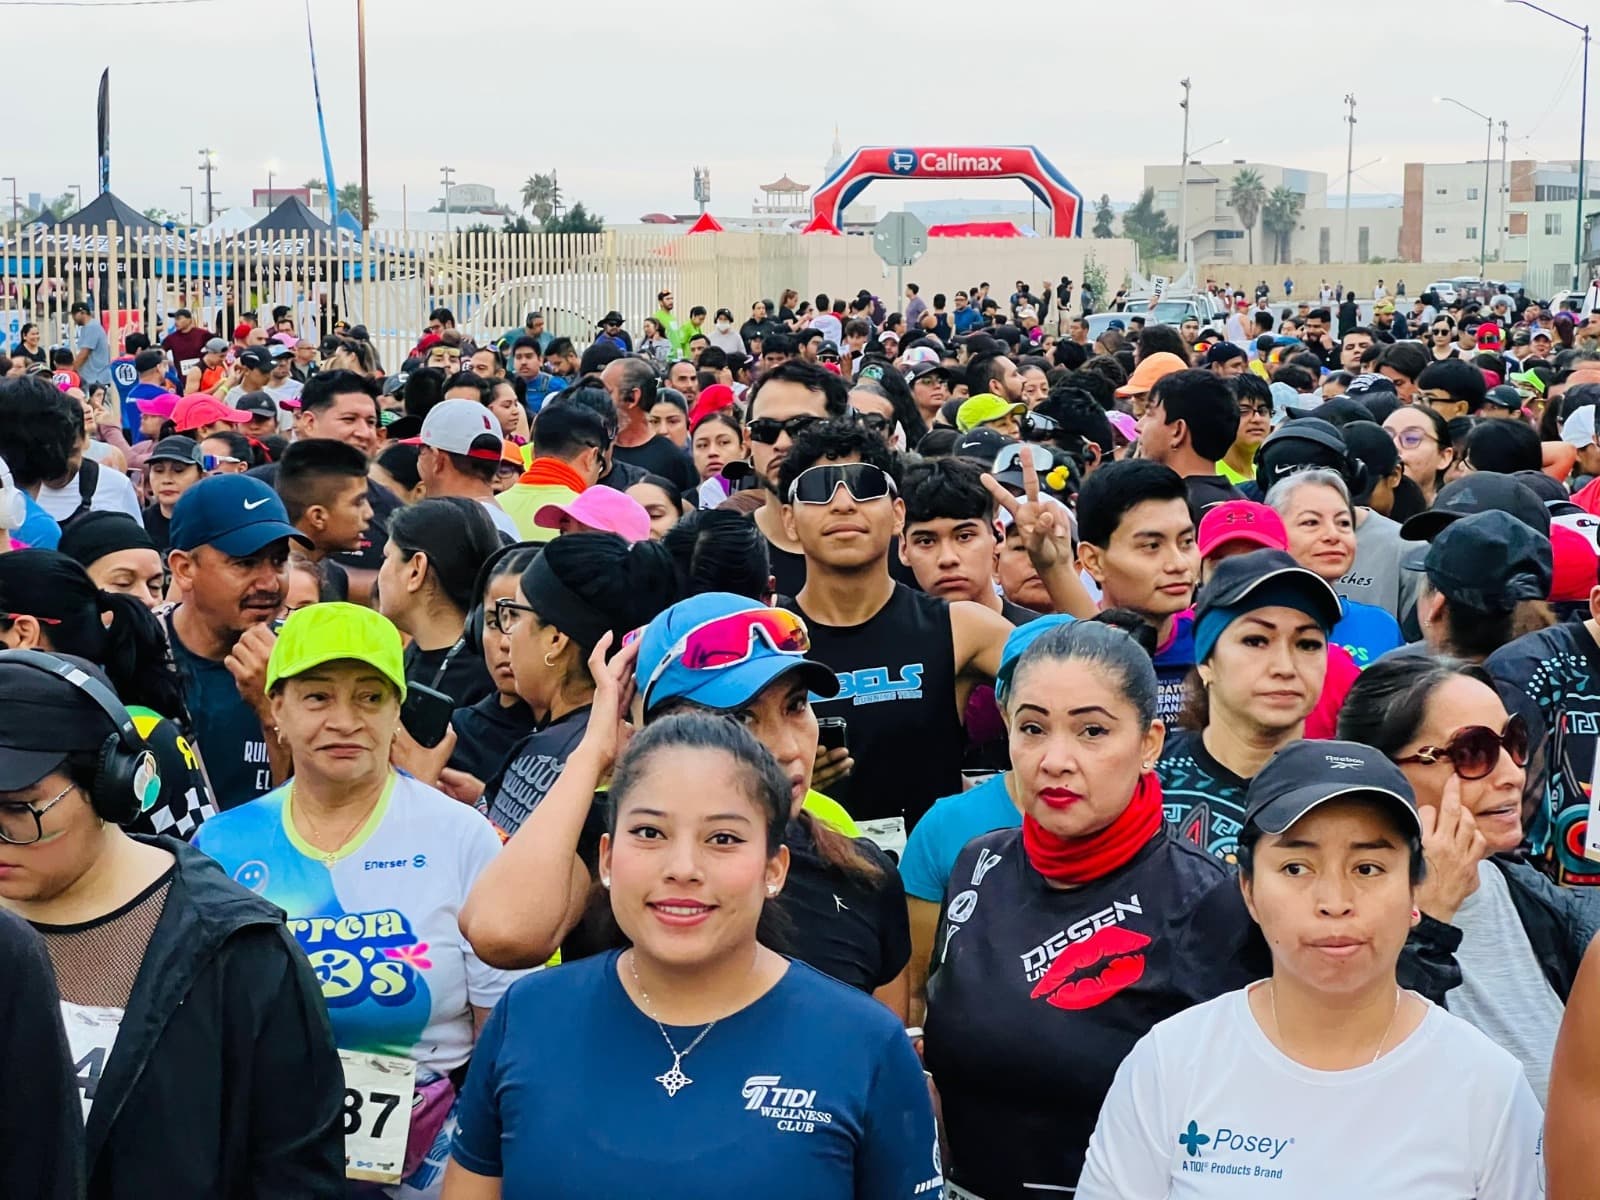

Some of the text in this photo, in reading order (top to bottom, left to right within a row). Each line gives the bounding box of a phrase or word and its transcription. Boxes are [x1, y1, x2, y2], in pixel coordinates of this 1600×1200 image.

[920, 152, 1003, 172] Calimax
[1340, 571, 1373, 586] ches
[364, 859, 407, 871] Enerser
[770, 1087, 817, 1109] TIDI
[344, 1087, 401, 1139] 87
[760, 1106, 833, 1124] WELLNESS
[777, 1120, 815, 1133] CLUB
[1211, 1162, 1251, 1176] Products
[1254, 1165, 1283, 1179] Brand
